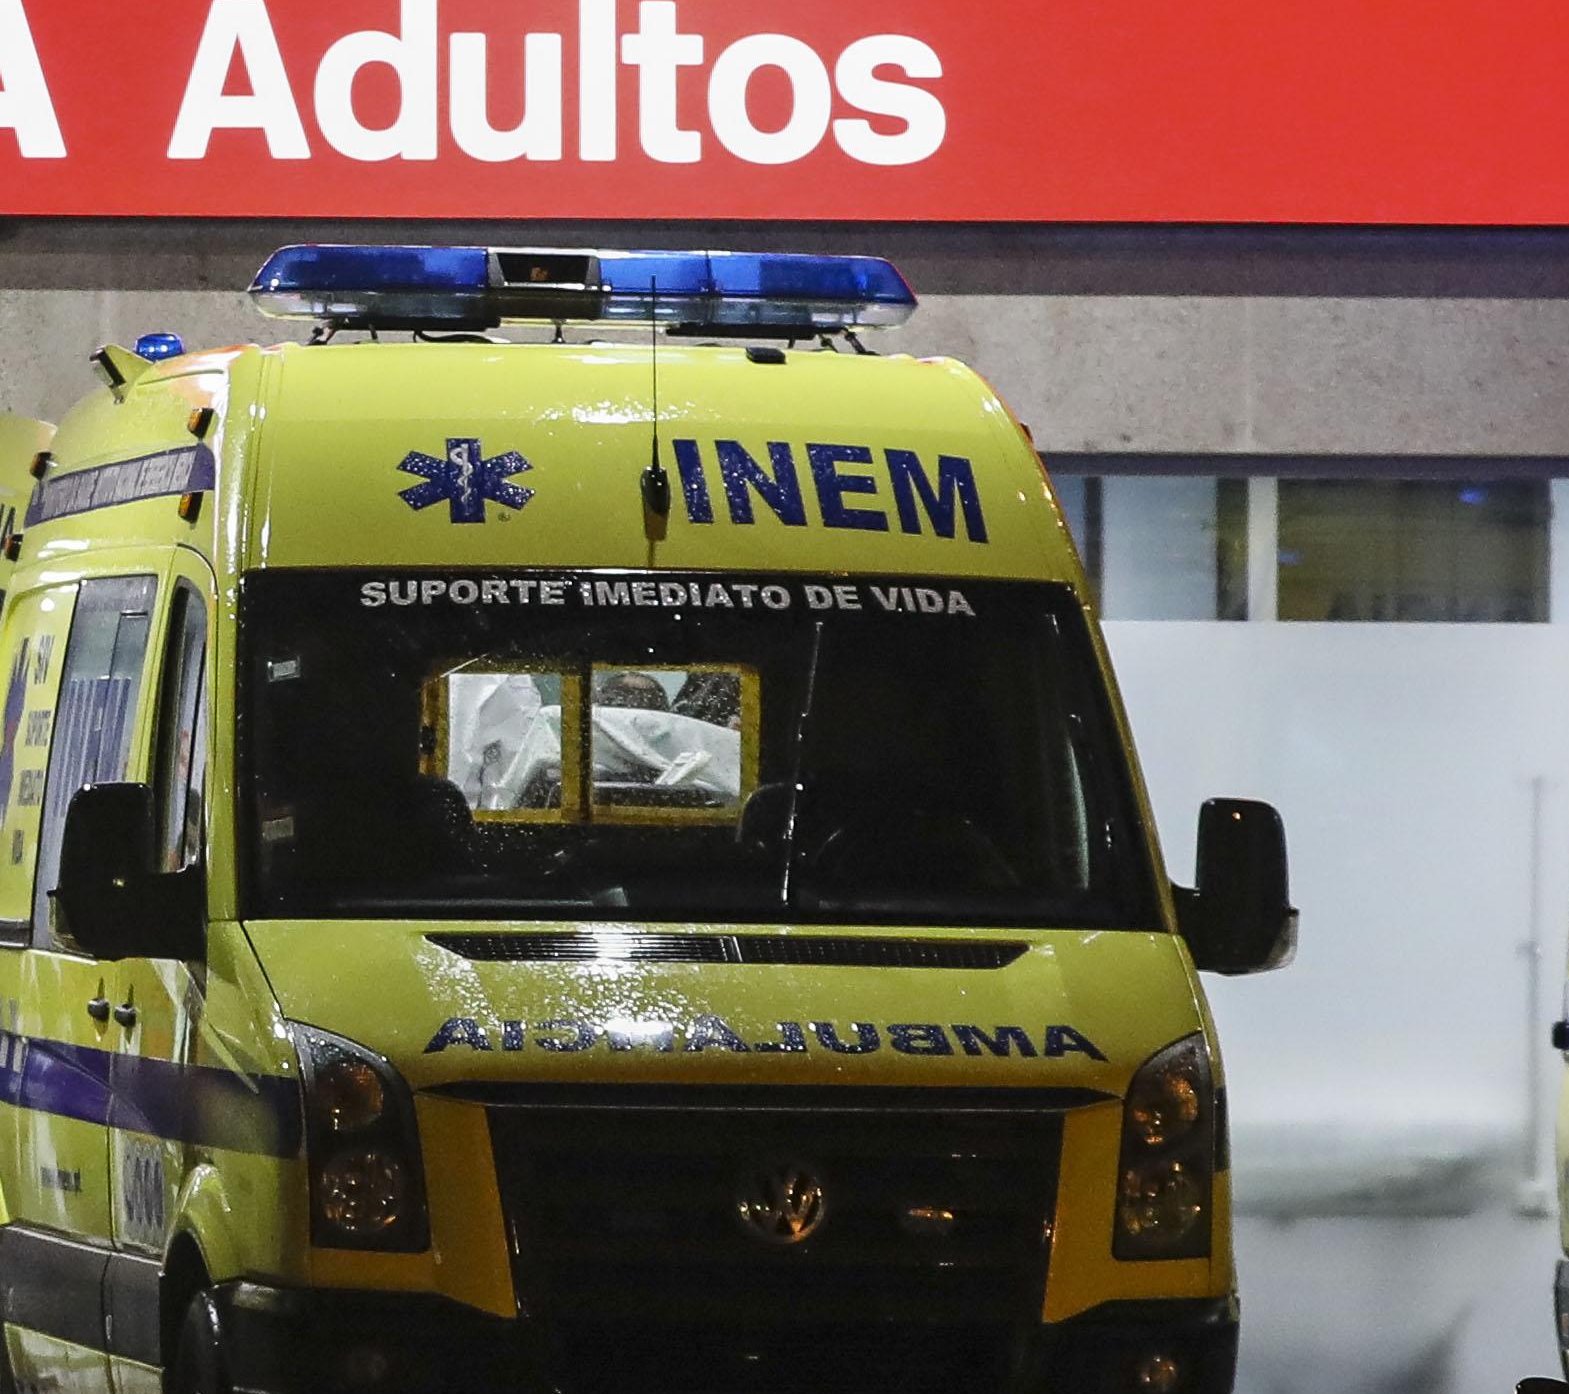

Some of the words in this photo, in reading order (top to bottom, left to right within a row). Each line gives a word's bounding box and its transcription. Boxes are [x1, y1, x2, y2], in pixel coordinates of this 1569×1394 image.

[672, 439, 990, 544] INEM
[361, 579, 565, 606] SUPORTE
[581, 580, 791, 609] IMEDIATO
[804, 583, 862, 610] DE
[870, 585, 976, 616] VIDA
